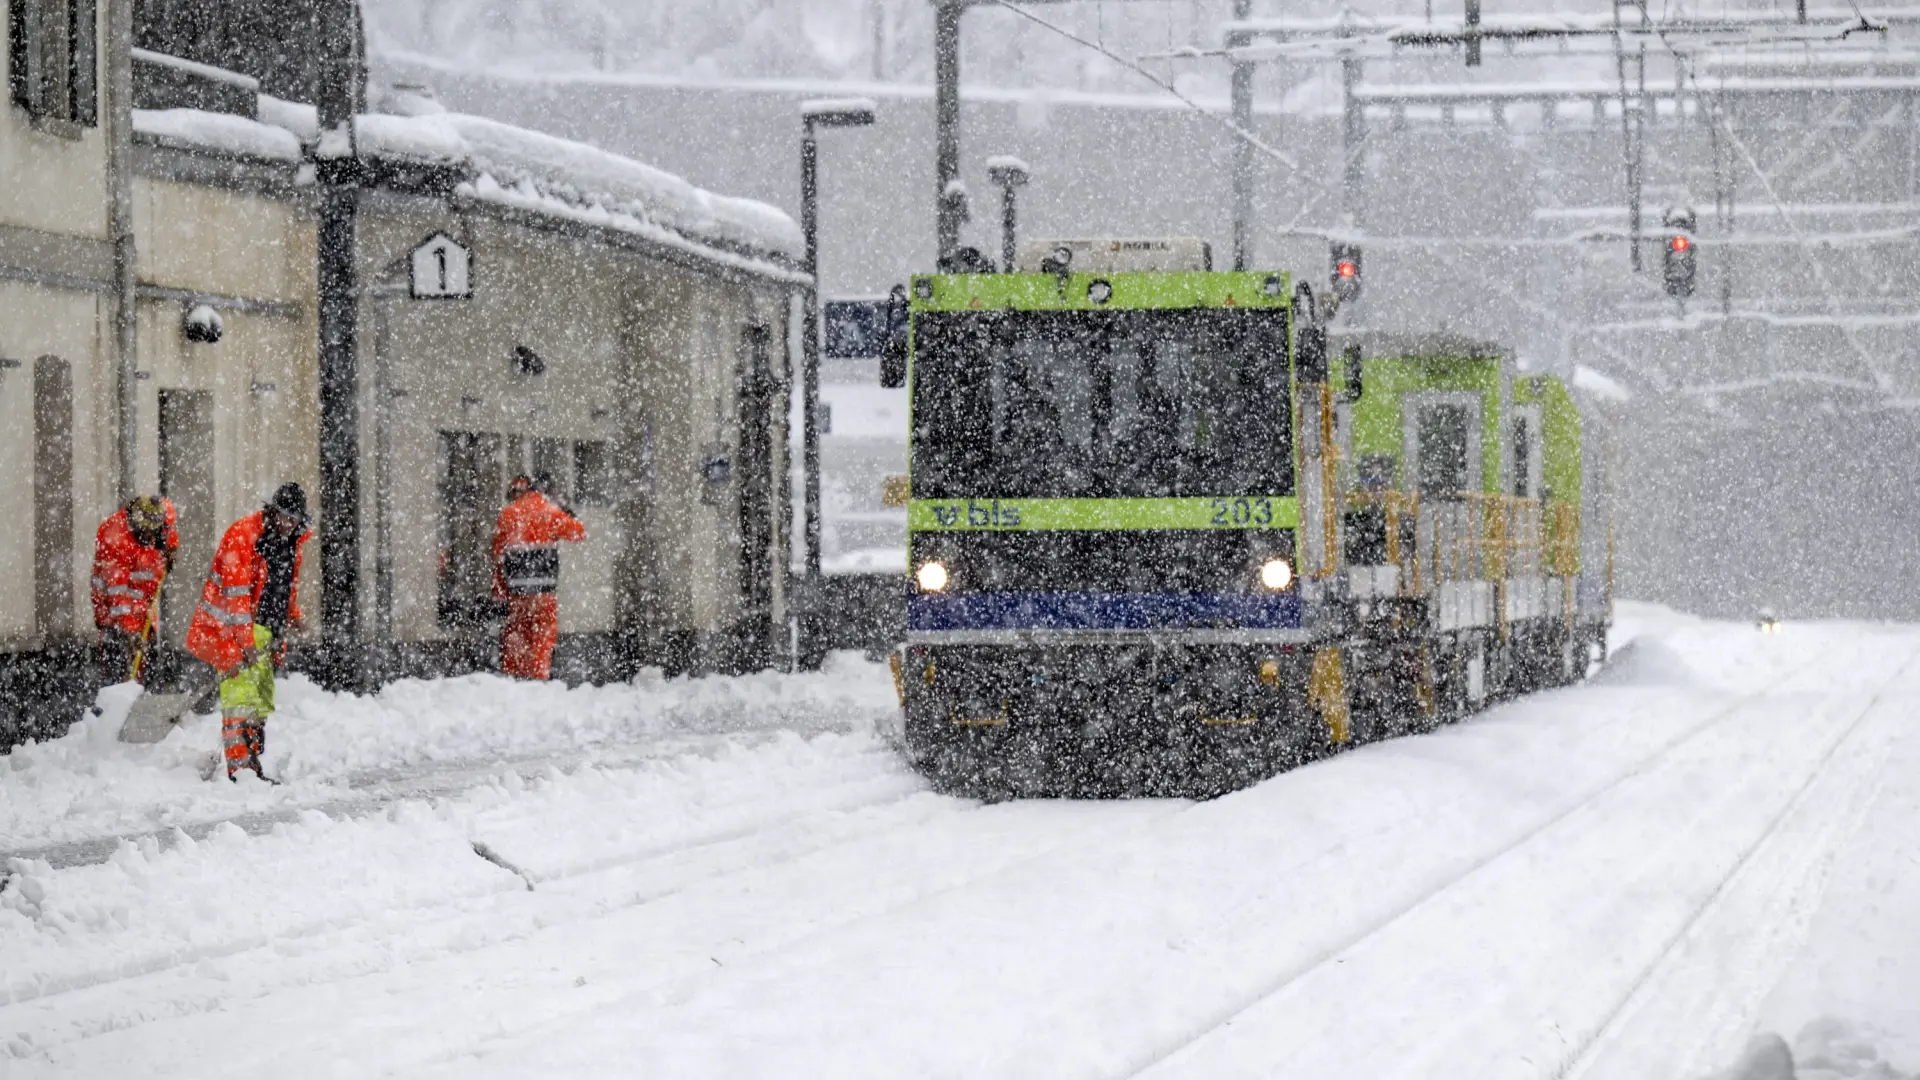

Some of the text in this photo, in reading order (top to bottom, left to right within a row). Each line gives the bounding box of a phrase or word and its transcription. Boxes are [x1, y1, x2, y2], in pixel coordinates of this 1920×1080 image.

[433, 247, 446, 290] 1
[968, 500, 1020, 526] bls
[1211, 499, 1272, 525] 203
